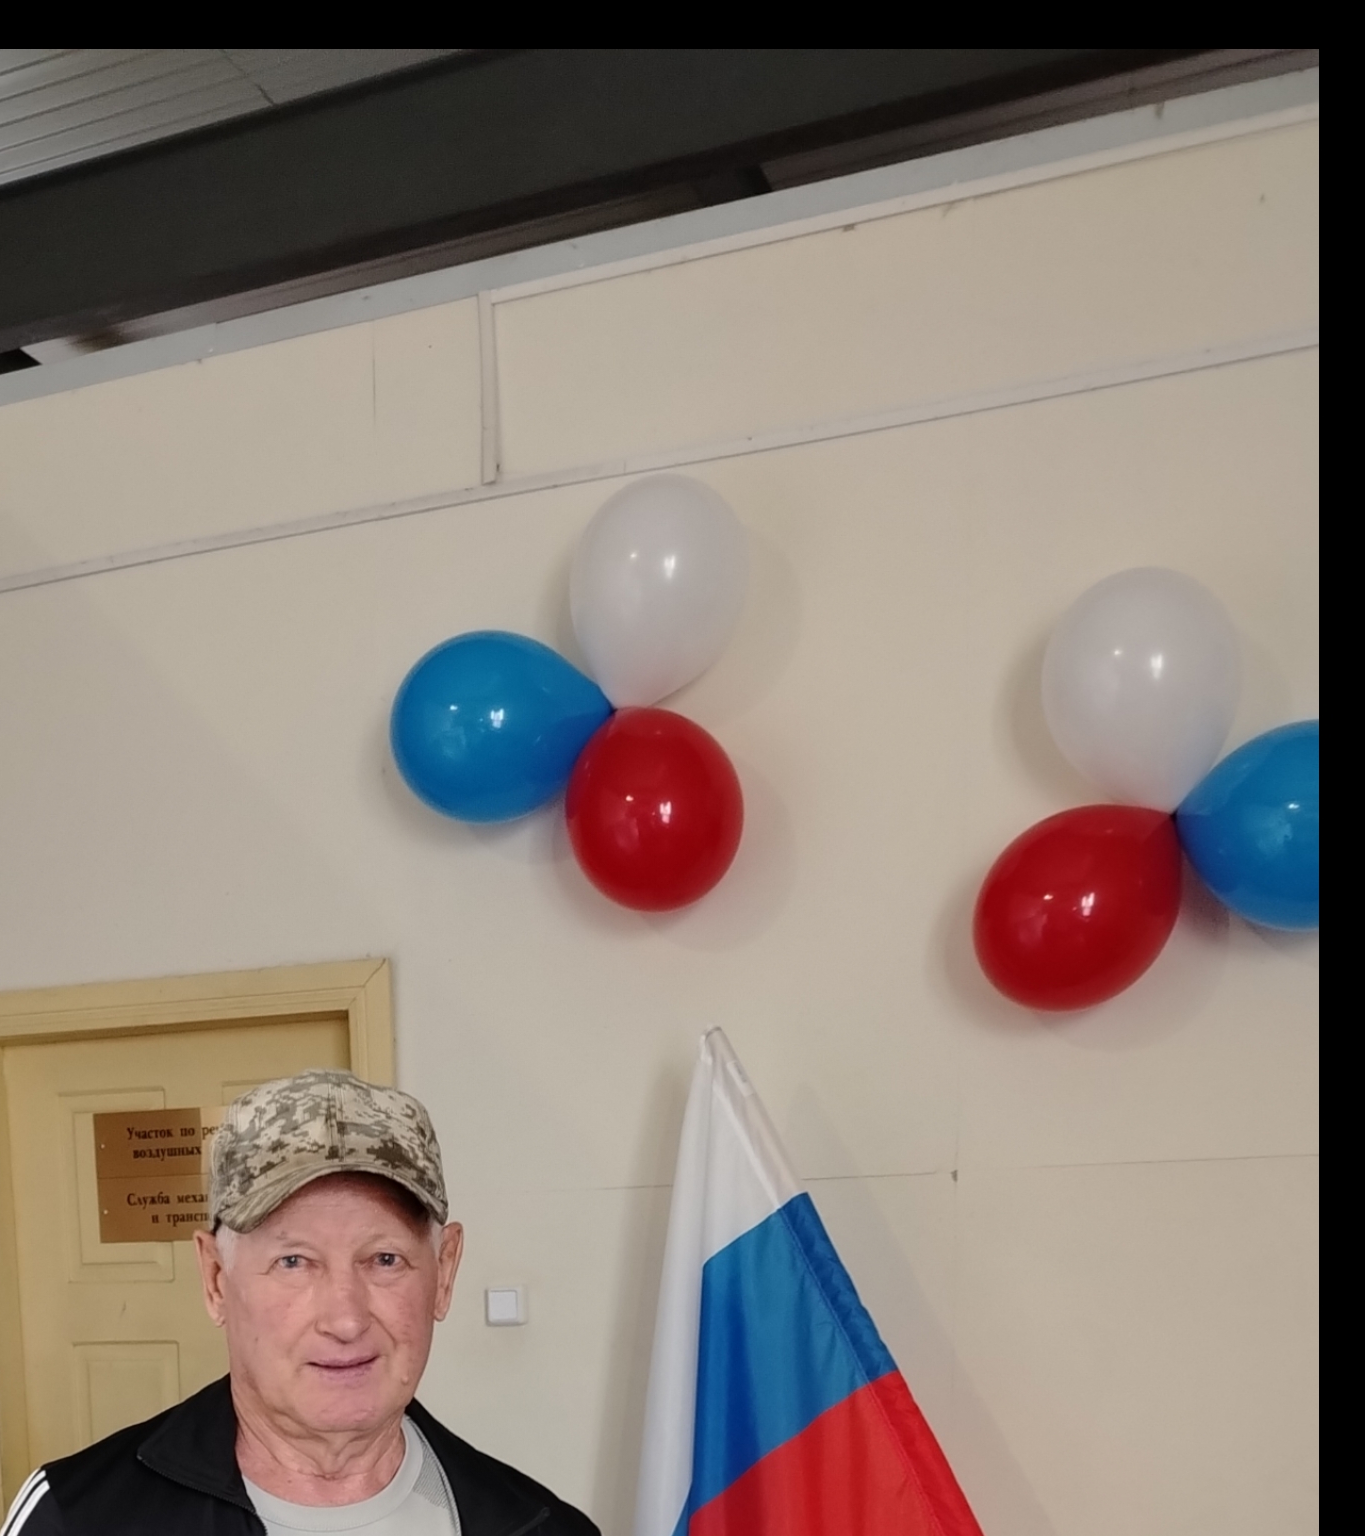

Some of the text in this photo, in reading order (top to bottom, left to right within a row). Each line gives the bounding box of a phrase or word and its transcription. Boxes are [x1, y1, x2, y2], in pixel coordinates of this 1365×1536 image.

[127, 1127, 174, 1140] Участок
[180, 1127, 195, 1137] по
[133, 1146, 202, 1161] воздушных
[127, 1191, 171, 1210] Служба
[151, 1214, 159, 1223] и
